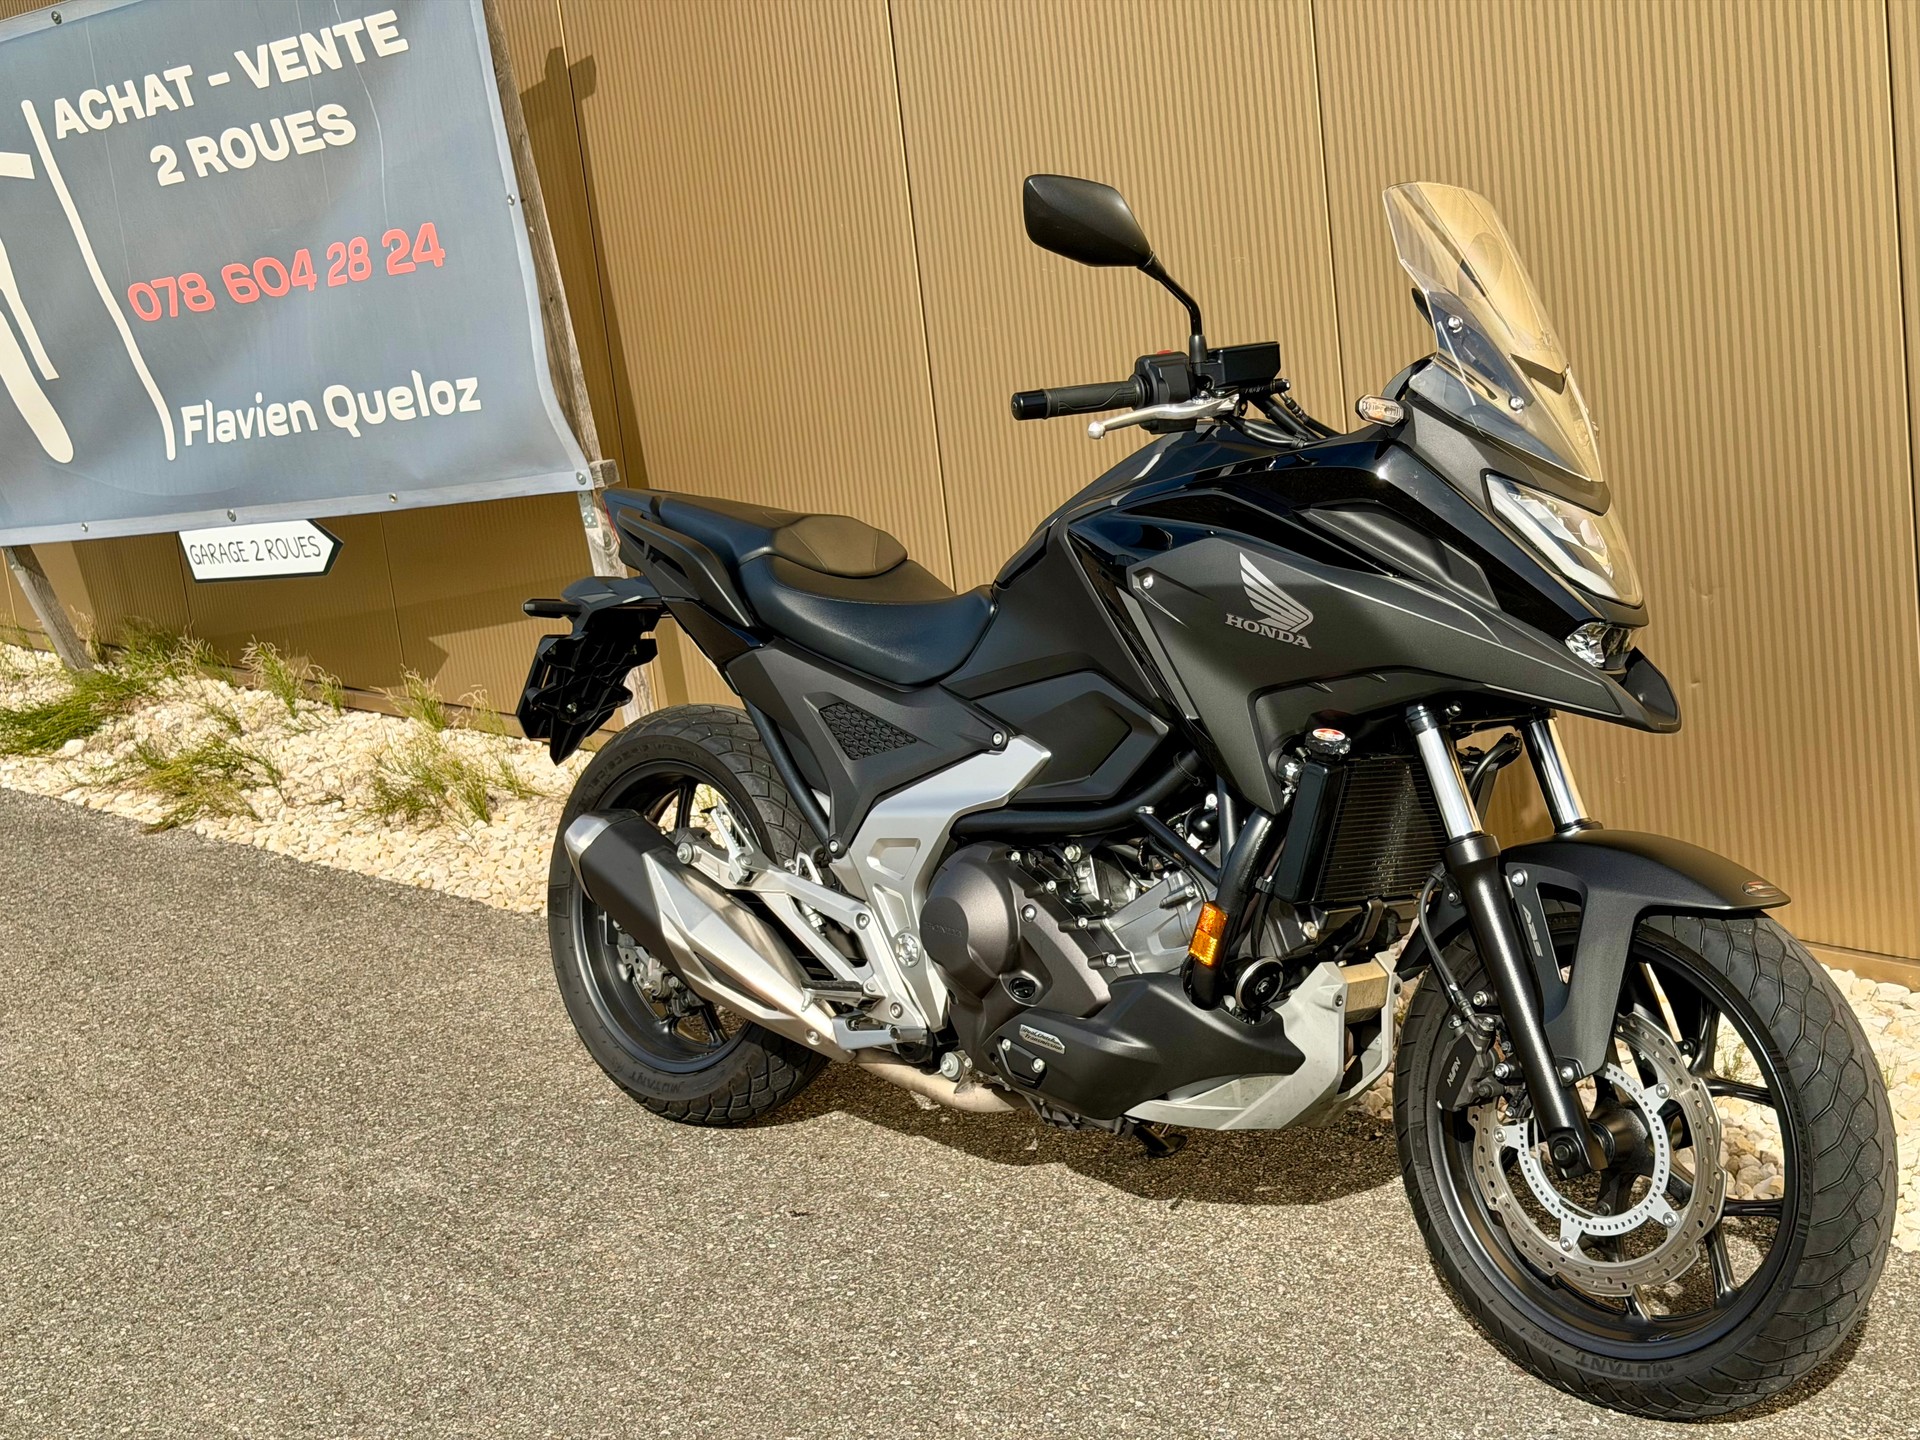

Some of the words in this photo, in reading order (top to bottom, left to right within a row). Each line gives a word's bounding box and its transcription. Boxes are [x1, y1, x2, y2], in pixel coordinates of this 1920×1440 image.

[54, 64, 195, 140] ACHAT
[207, 71, 230, 87] -
[233, 9, 409, 89] VENTE
[149, 144, 185, 187] 2
[185, 103, 357, 178] ROUES
[127, 272, 216, 322] 078
[221, 248, 318, 304] 604
[326, 237, 372, 287] 28
[381, 222, 446, 276] 24
[180, 392, 319, 446] Flavien
[323, 369, 482, 438] Queloz
[189, 541, 250, 566] GARAGE
[250, 539, 265, 562] 2
[264, 535, 322, 561] ROUES
[1225, 613, 1312, 649] HONDA
[1521, 903, 1544, 957] ABS
[1575, 1354, 1671, 1378] MUTANT
